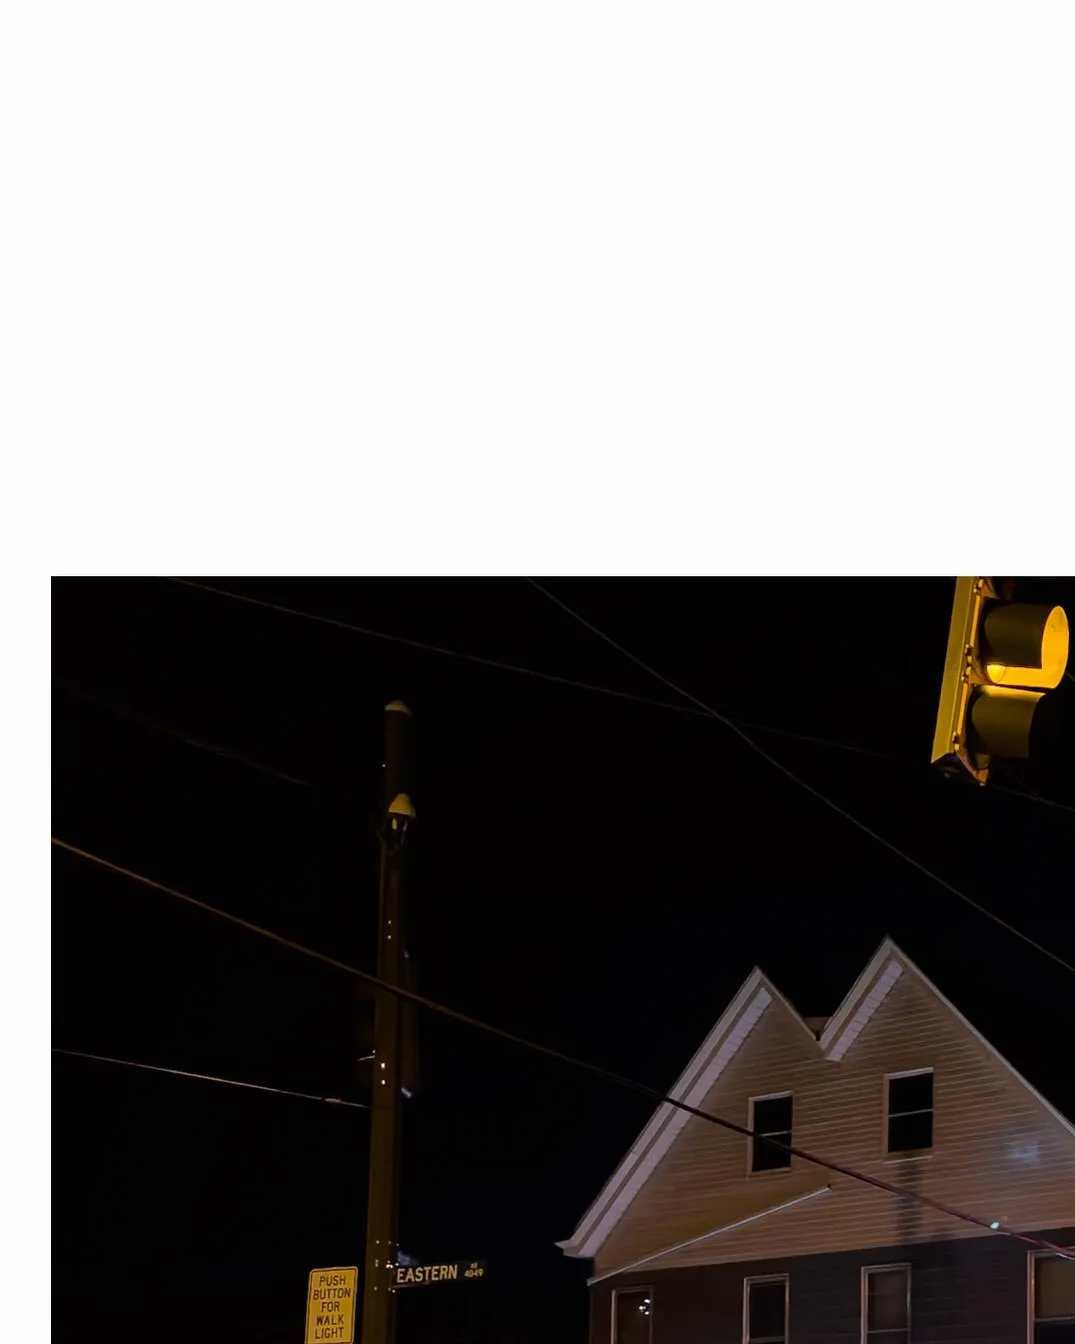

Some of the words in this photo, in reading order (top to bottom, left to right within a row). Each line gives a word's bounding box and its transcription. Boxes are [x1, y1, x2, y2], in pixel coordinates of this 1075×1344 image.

[396, 1264, 458, 1283] EASTERN
[319, 1275, 347, 1287] PUSH
[313, 1287, 351, 1300] BUTTON
[321, 1301, 340, 1312] FOR
[316, 1314, 344, 1325] WALK
[314, 1327, 344, 1339] LIGHT
